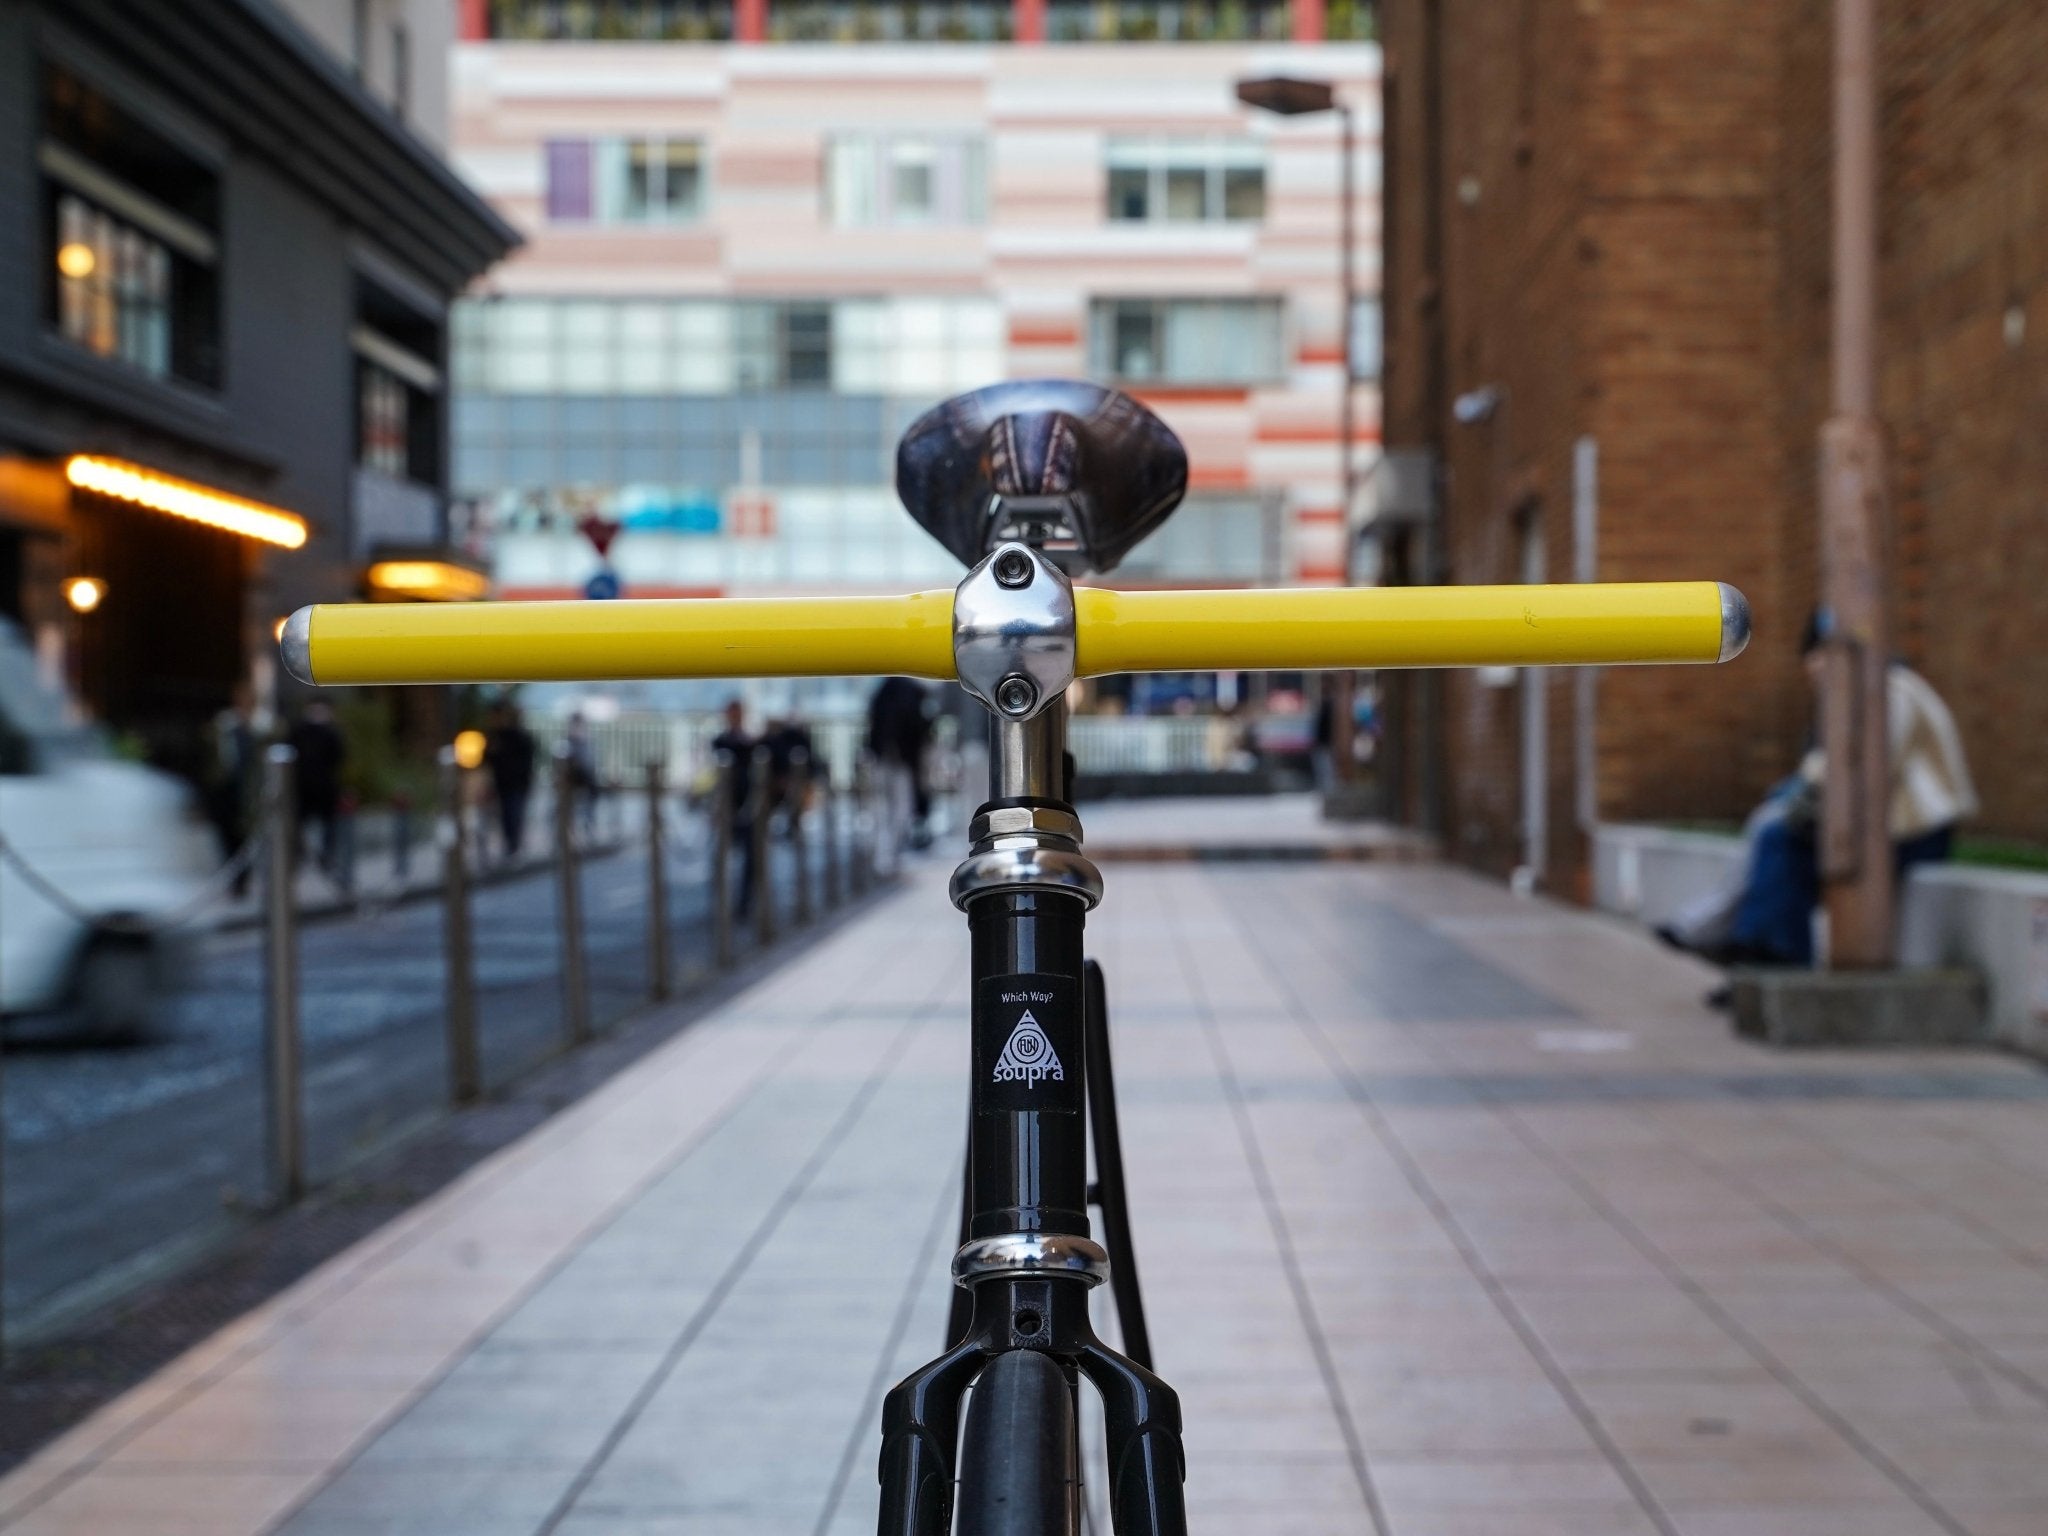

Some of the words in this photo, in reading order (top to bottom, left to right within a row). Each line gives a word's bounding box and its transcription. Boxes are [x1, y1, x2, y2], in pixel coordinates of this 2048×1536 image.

[1001, 991, 1028, 1003] Which
[1030, 991, 1054, 1004] Way?
[992, 1067, 1065, 1090] soupra
